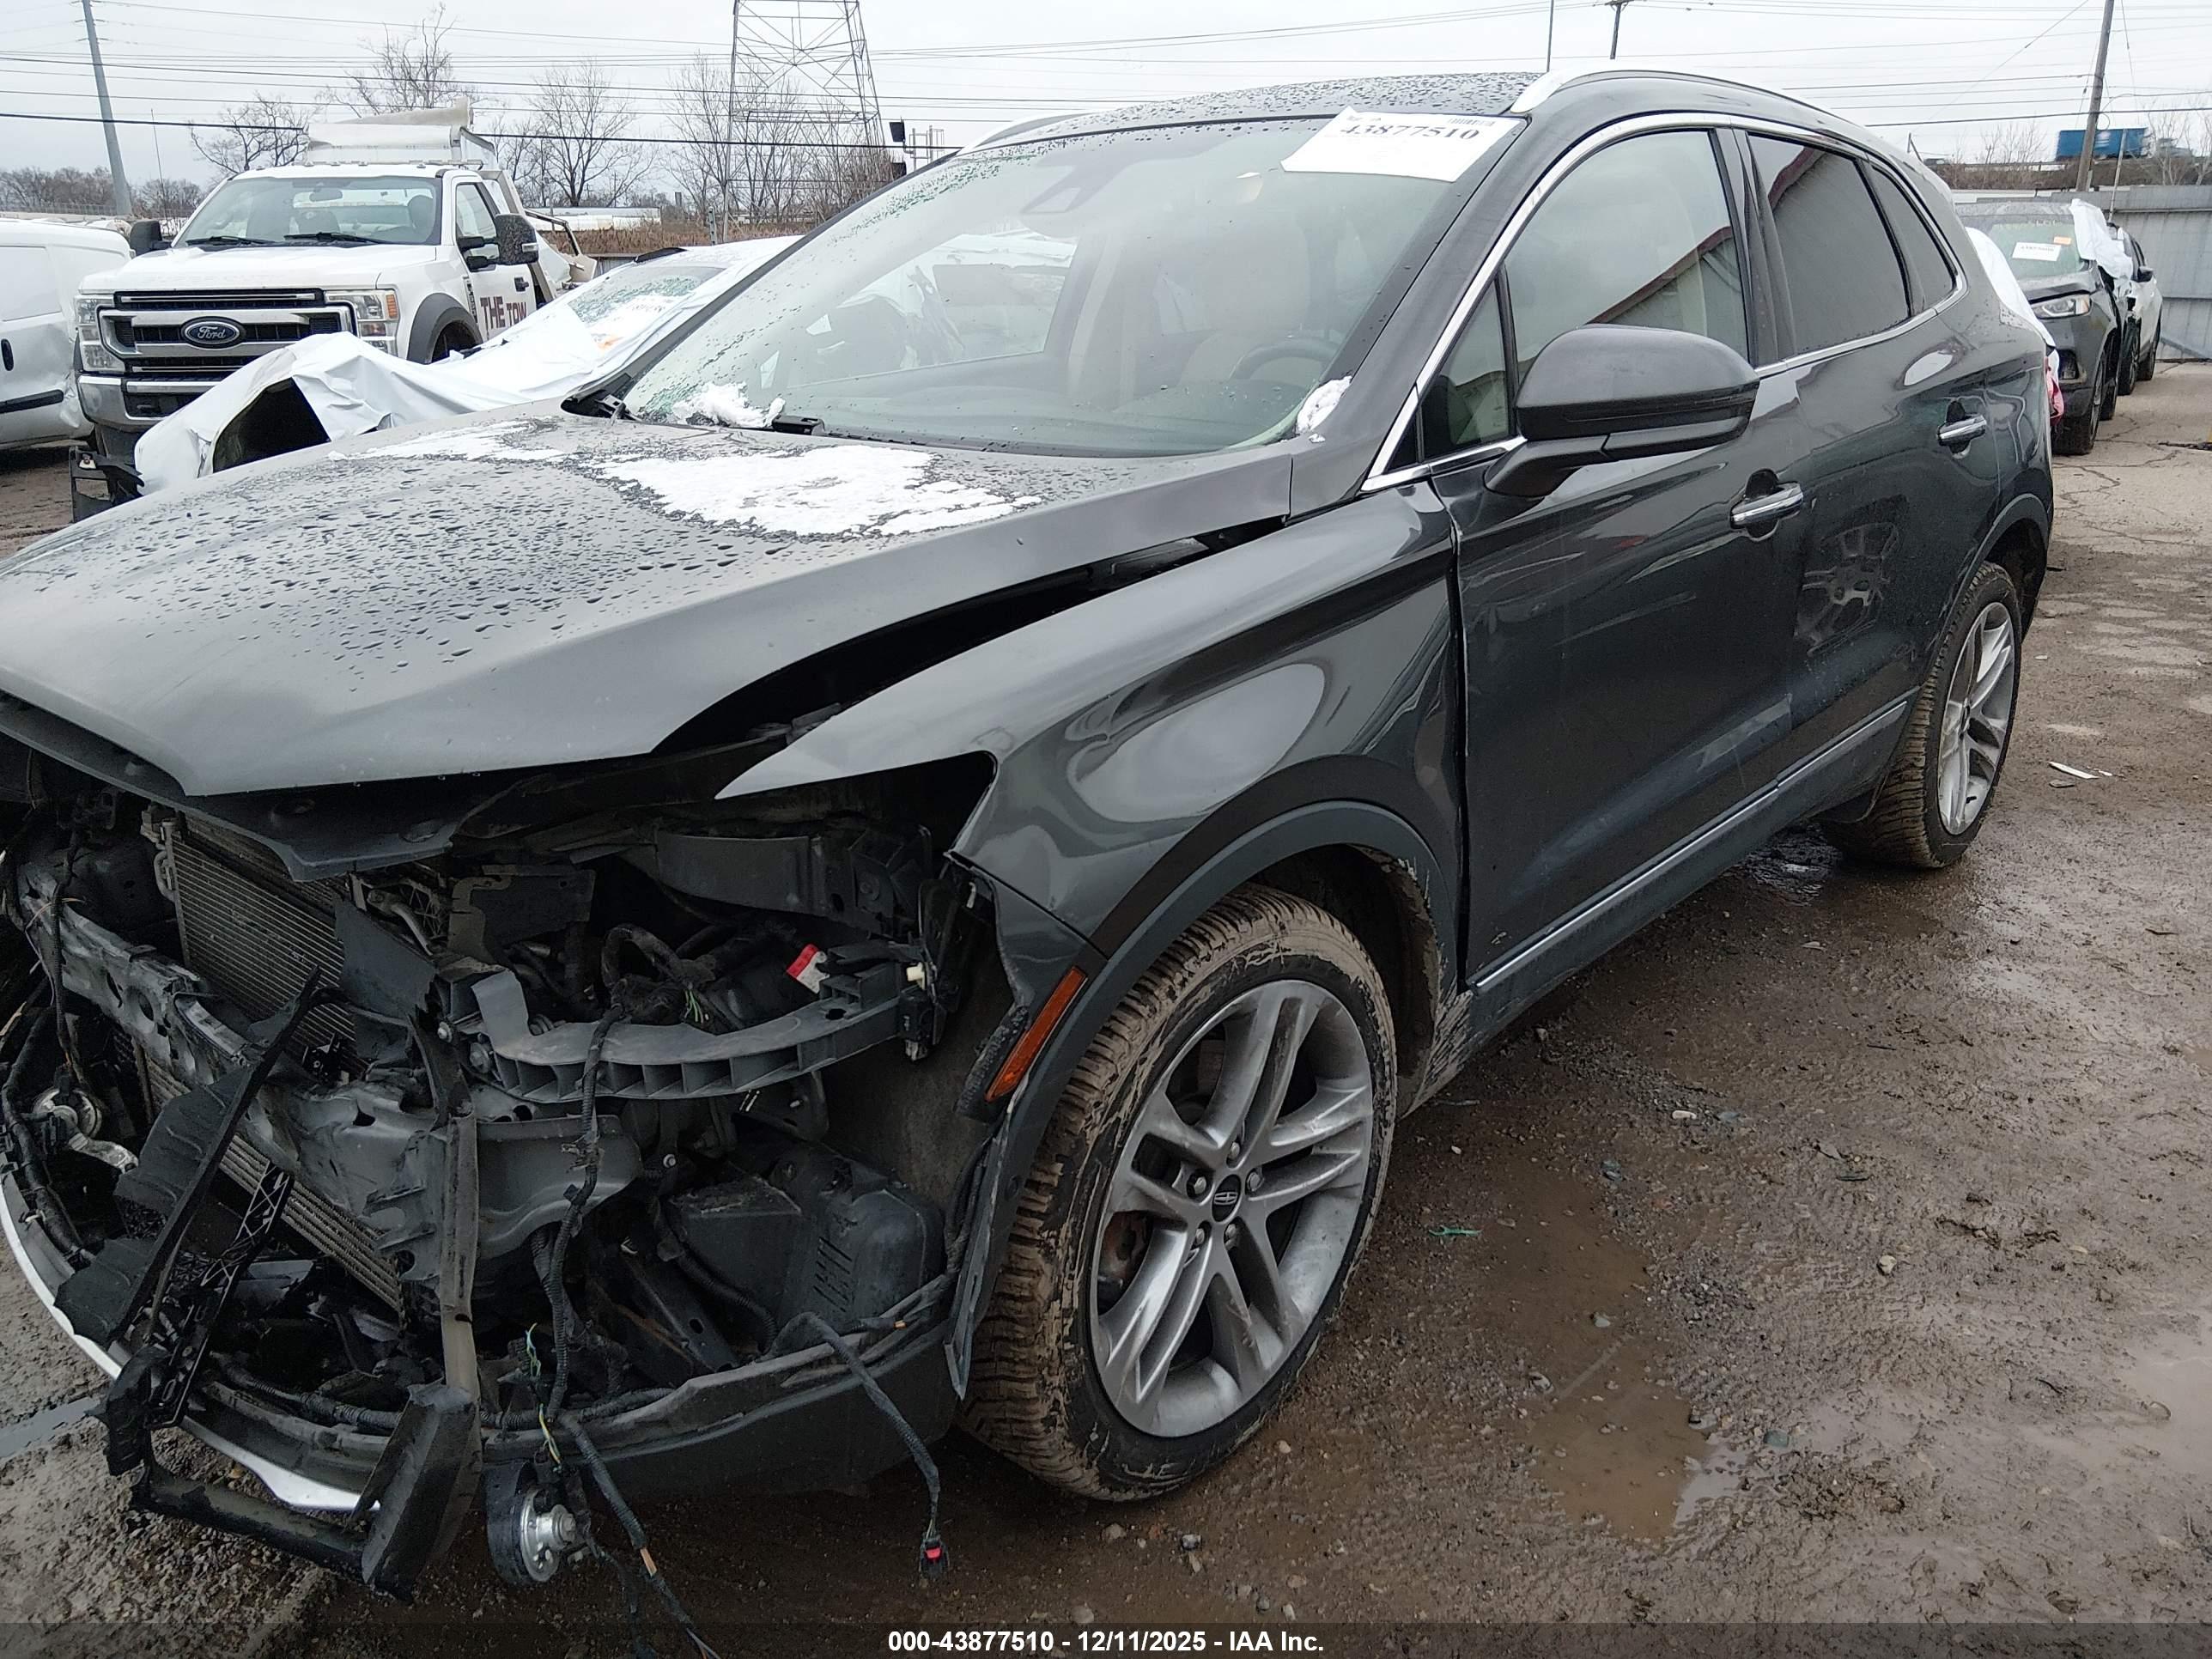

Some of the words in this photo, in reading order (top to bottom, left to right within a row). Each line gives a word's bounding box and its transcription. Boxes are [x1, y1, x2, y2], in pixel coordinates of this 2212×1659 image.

[1340, 125, 1480, 140] 43877510
[479, 296, 506, 331] THE
[506, 302, 527, 326] TOW
[197, 325, 227, 339] Ford
